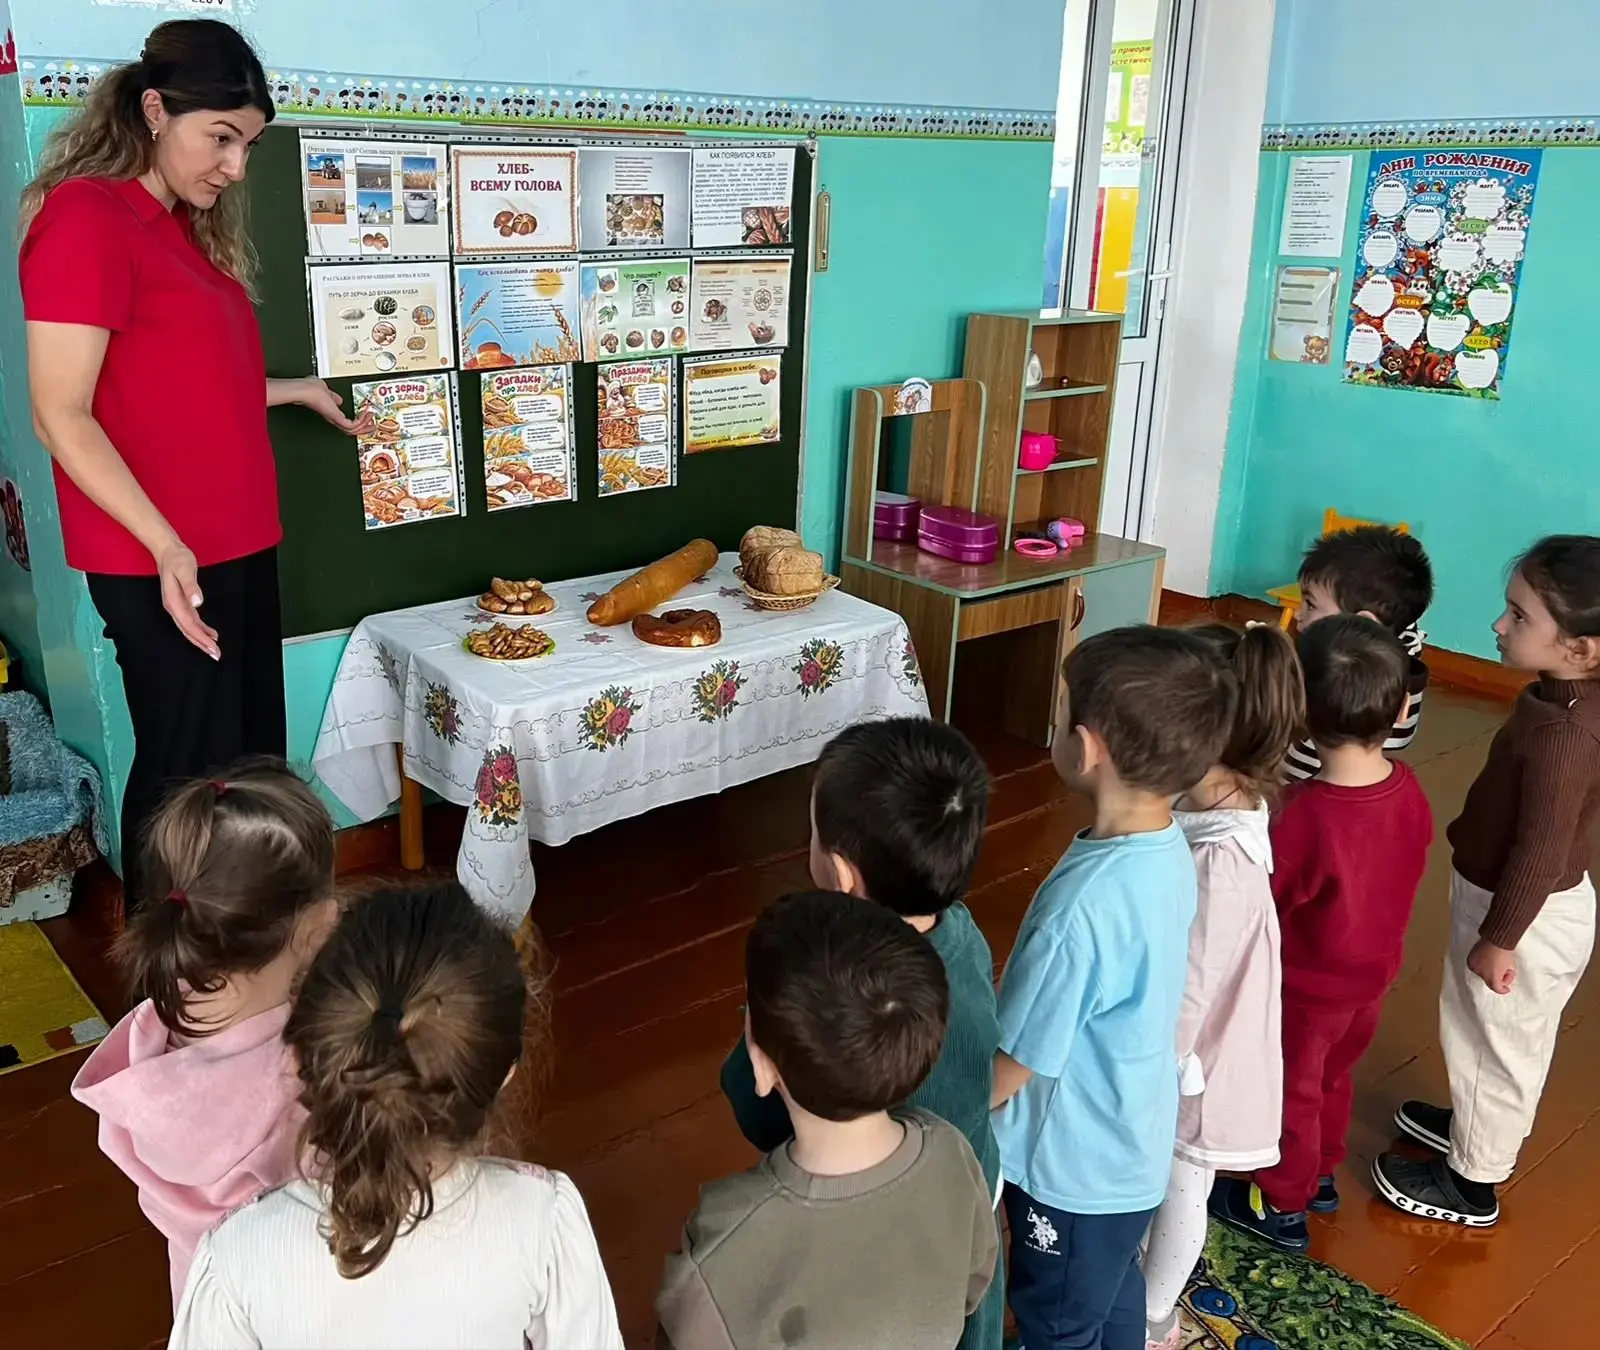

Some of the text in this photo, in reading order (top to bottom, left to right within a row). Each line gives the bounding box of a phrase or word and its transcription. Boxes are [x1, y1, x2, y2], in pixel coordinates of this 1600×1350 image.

[721, 151, 755, 159] ПОЯВИЛСЯ
[756, 151, 776, 159] ХЛЕБ?
[497, 163, 534, 174] ХЛЕБ-
[1379, 153, 1531, 175] ДНИ РОЖДЕНИЯ
[470, 180, 562, 191] ВСЕМУ ГОЛОВА
[610, 366, 653, 378] Праздник
[495, 374, 541, 390] Загадки
[622, 375, 648, 384] хлеба
[378, 384, 425, 396] От зерна
[501, 384, 539, 395] про хлеб
[383, 392, 425, 405] до хлеба
[1396, 1196, 1468, 1224] crocs
